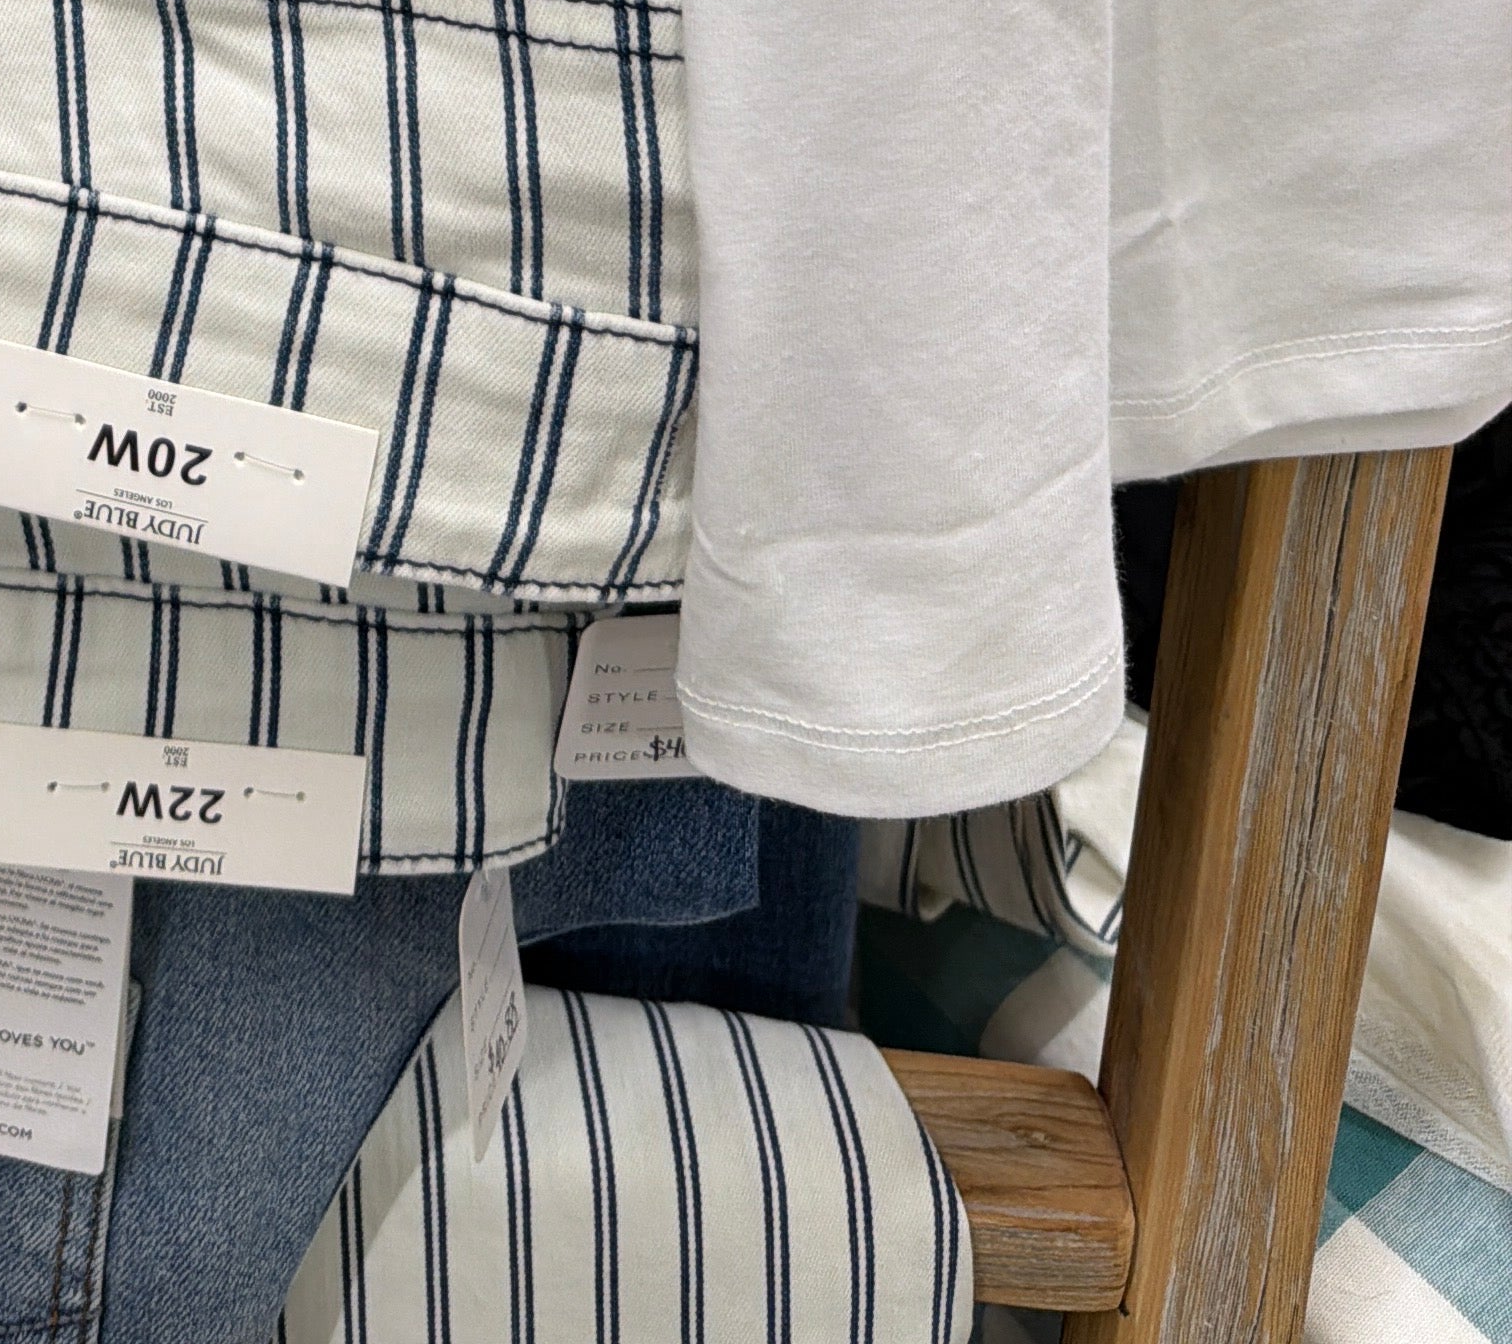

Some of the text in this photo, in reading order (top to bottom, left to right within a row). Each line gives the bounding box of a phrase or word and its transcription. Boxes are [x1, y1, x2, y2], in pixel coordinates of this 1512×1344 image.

[147, 388, 177, 405] 2000
[87, 423, 213, 485] 20W
[113, 488, 173, 509] LOS ANGELES
[142, 514, 205, 544] JUDY
[588, 690, 658, 704] STYLE
[581, 721, 630, 734] SIZE
[163, 745, 190, 757] 2000
[574, 751, 640, 763] PRICE
[116, 780, 226, 824] 22W
[143, 835, 195, 847] LOS ANGELES
[170, 854, 225, 876] JUDY
